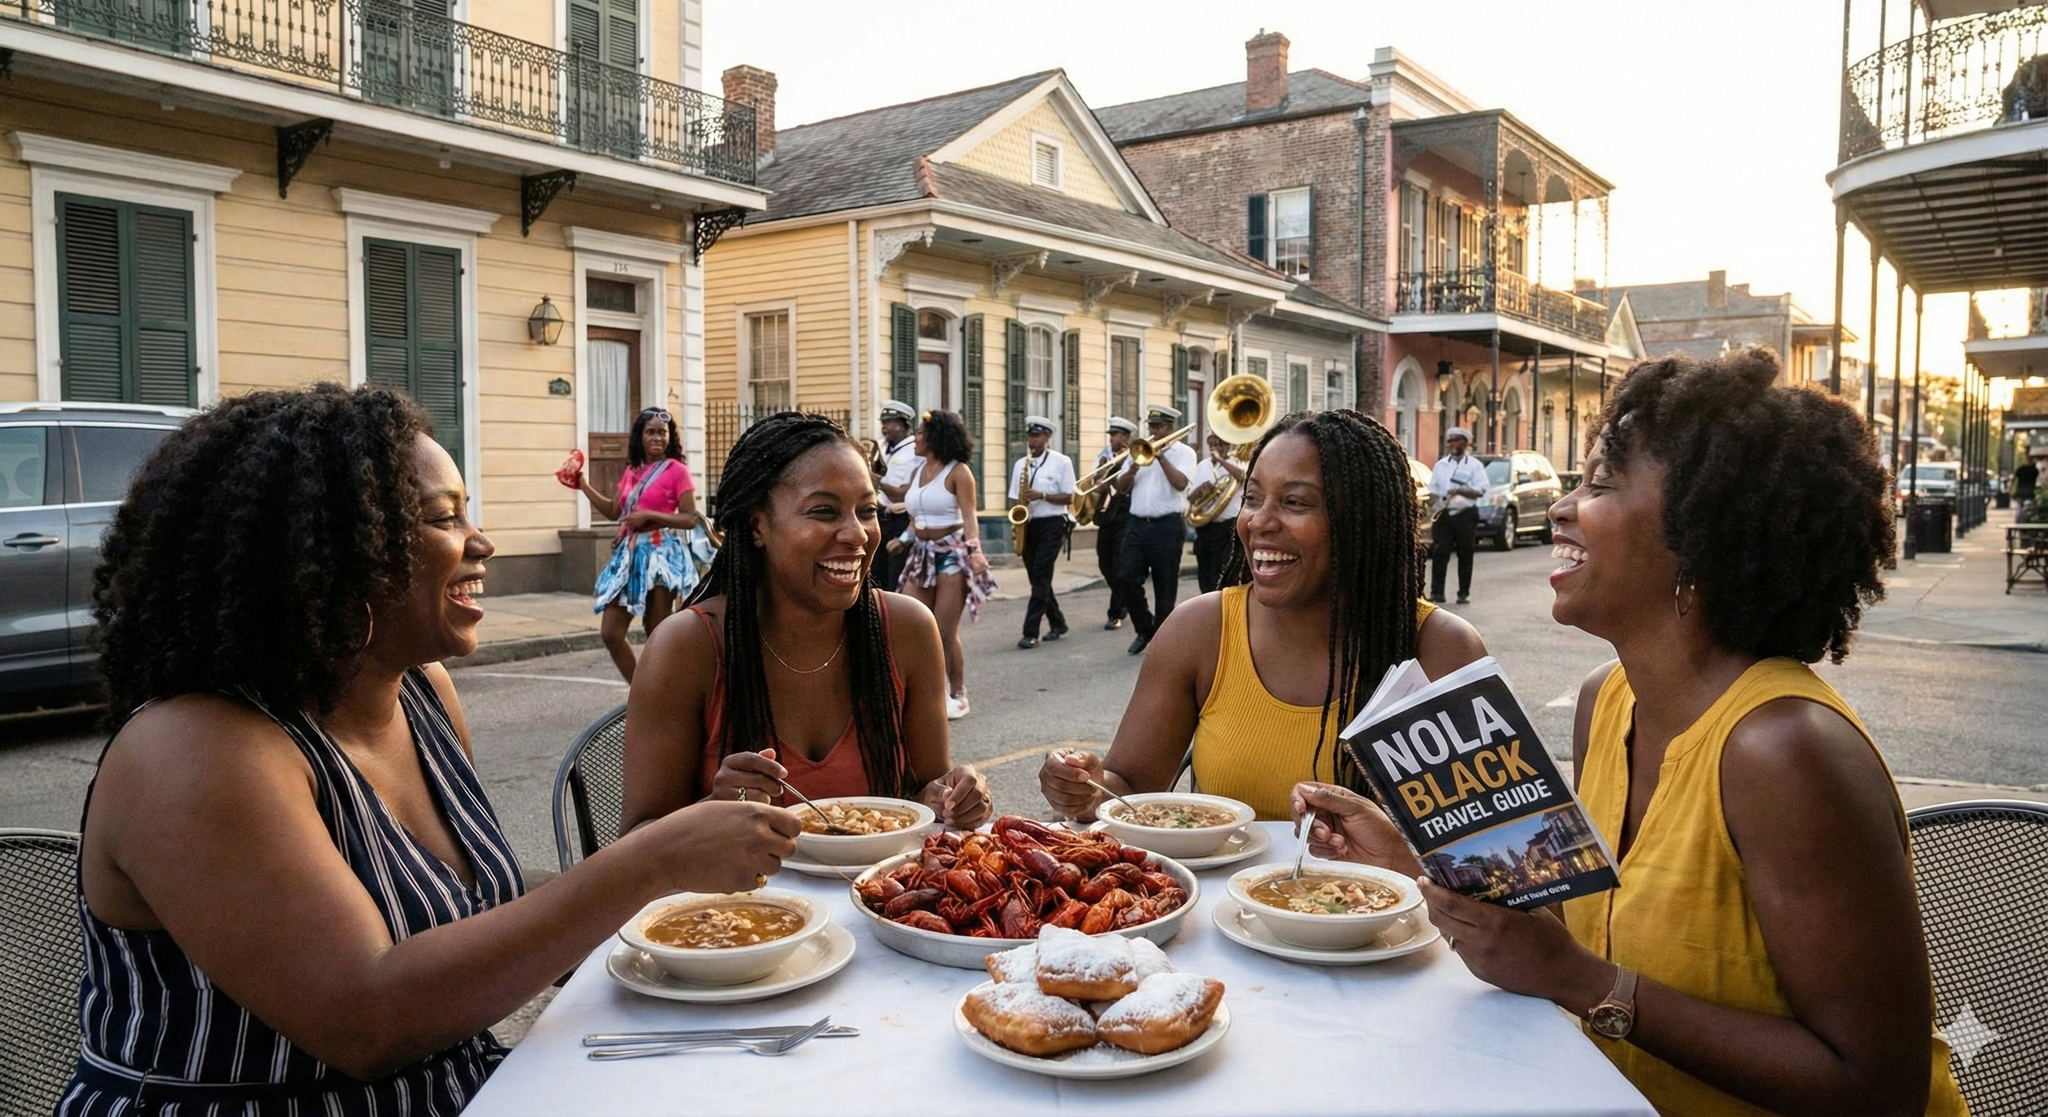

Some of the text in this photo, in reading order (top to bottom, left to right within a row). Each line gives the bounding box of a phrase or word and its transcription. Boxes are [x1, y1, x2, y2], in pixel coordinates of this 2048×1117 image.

[1372, 696, 1516, 783] NOLA
[1398, 739, 1538, 820] BLACK
[1420, 801, 1493, 840] TRAVEL
[1492, 779, 1552, 819] GUIDE
